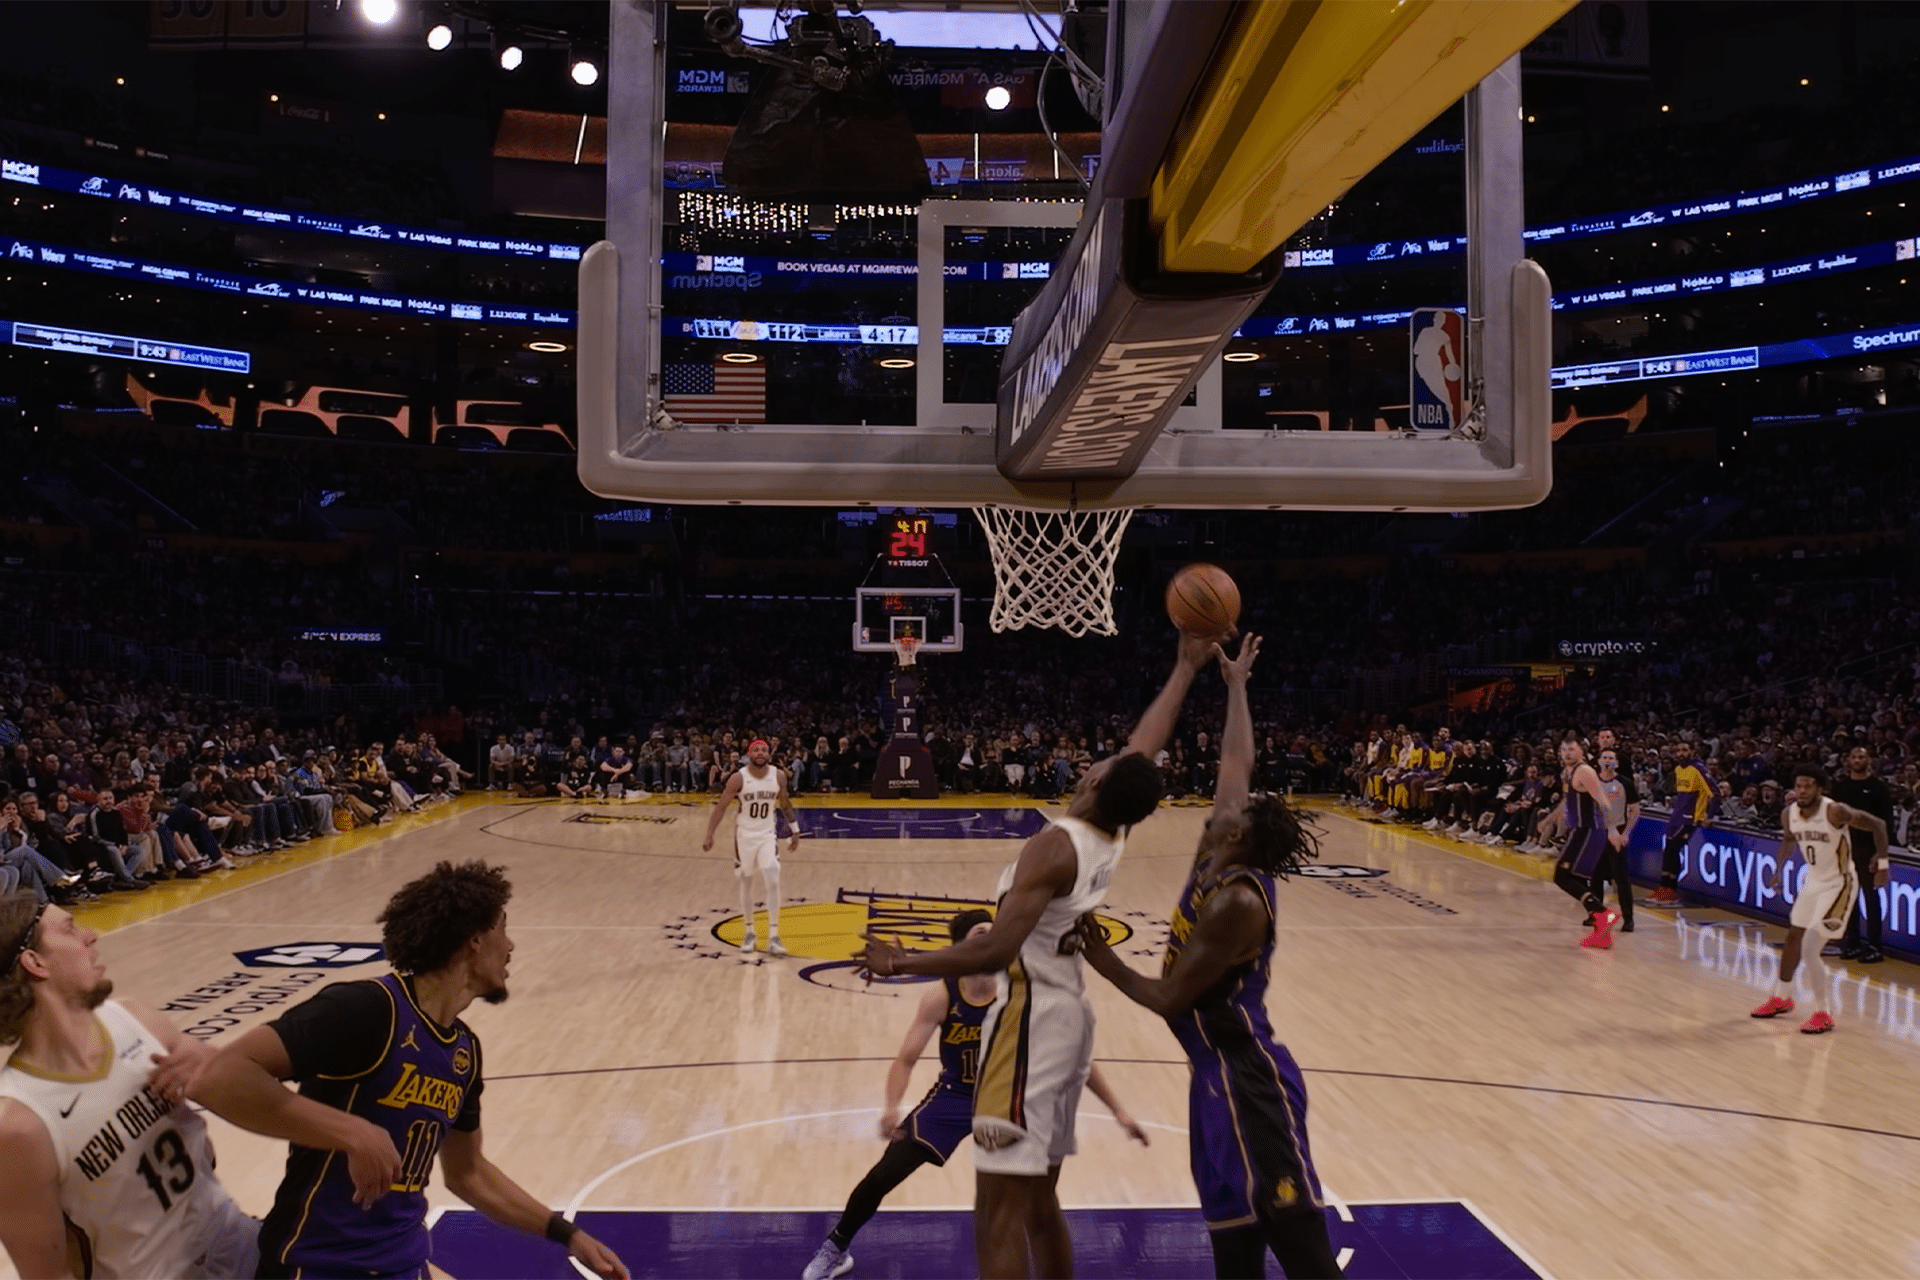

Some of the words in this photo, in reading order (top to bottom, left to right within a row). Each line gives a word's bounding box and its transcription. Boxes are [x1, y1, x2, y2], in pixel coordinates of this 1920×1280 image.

[2, 159, 39, 178] MGM
[714, 256, 744, 267] MGM
[1301, 249, 1334, 260] MGM
[777, 261, 808, 272] BOOK
[810, 263, 845, 273] VEGAS
[847, 264, 860, 273] AT
[1019, 262, 1050, 273] MGM
[1772, 262, 1812, 277] LUXOR
[489, 309, 527, 320] LUXOR
[868, 328, 907, 342] 4:17
[943, 330, 978, 342] elicans
[1040, 334, 1222, 470] LAKERS.COM
[1418, 404, 1443, 424] NBA
[891, 532, 925, 556] 24
[750, 802, 769, 819] 00
[1806, 845, 1816, 866] 0
[182, 971, 325, 1041] CRYPTO.CO
[944, 1022, 981, 1045] LAK
[962, 1048, 980, 1084] 1
[376, 1061, 463, 1120] LAKERS
[74, 1121, 125, 1182] NEW
[390, 1119, 440, 1193] 11
[136, 1128, 195, 1213] 13
